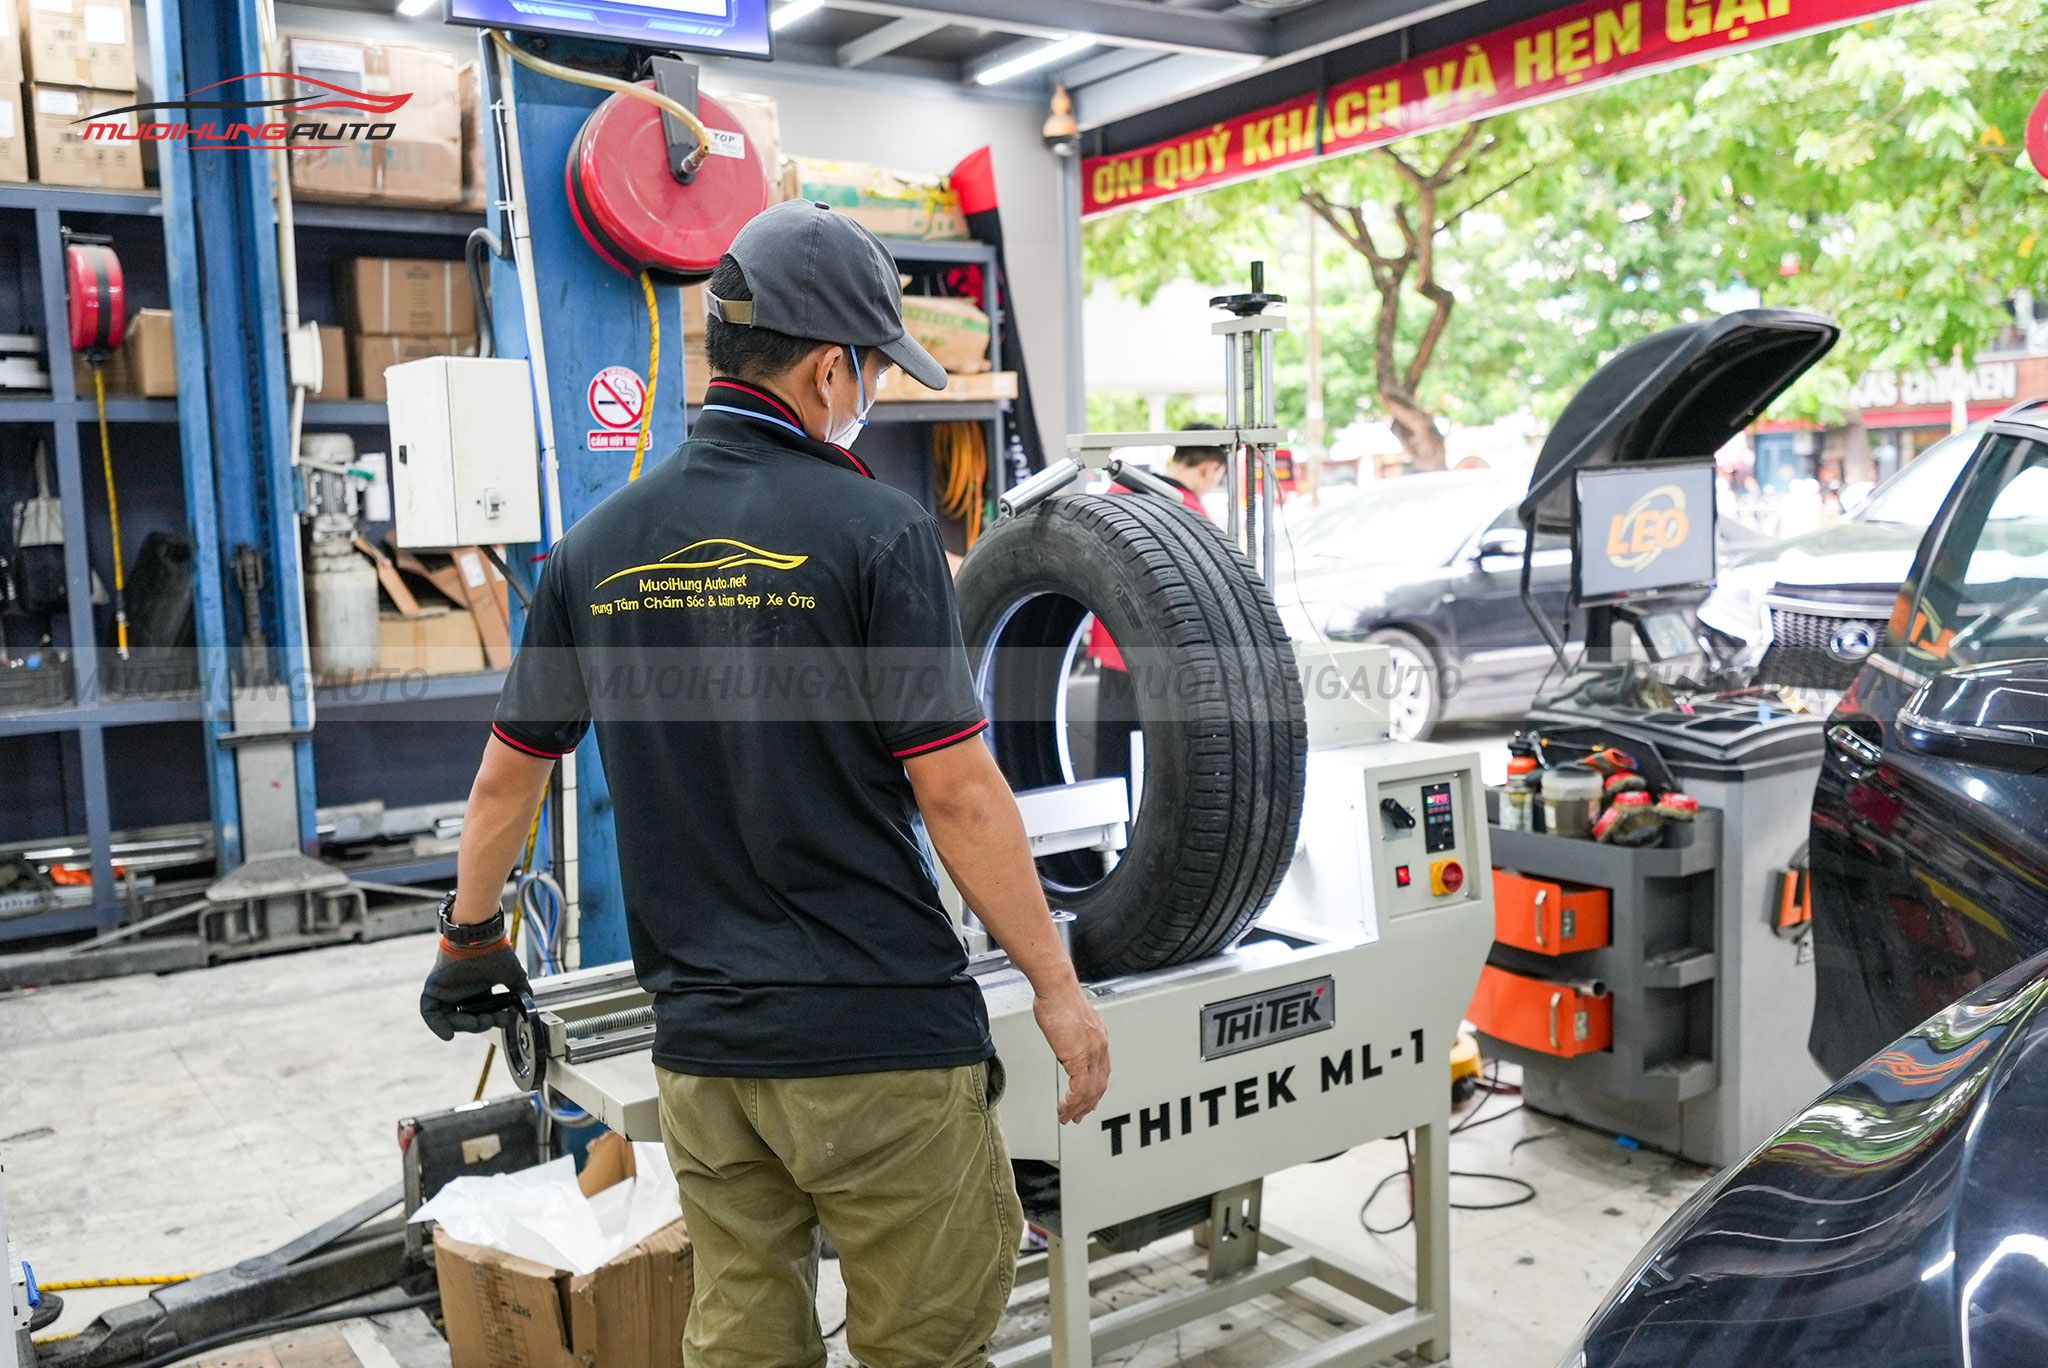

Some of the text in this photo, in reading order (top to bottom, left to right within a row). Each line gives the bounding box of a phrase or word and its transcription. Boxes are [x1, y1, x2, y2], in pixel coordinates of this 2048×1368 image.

[1093, 157, 1145, 204] ƠN
[1154, 123, 1233, 190] QUÝ
[1423, 43, 1498, 109] VÀ
[1513, 1, 1643, 86] HẸN
[1607, 507, 1690, 556] LEO
[590, 603, 613, 616] Trung
[614, 597, 640, 612] Tâm
[643, 595, 684, 609] Chăm
[686, 594, 705, 608] Sóc
[708, 595, 716, 607] &
[737, 593, 761, 609] Đẹp
[766, 592, 784, 606] Xe
[639, 573, 747, 593] MuoiHung Auto.net
[1101, 1028, 1425, 1157] THITEK ML-1
